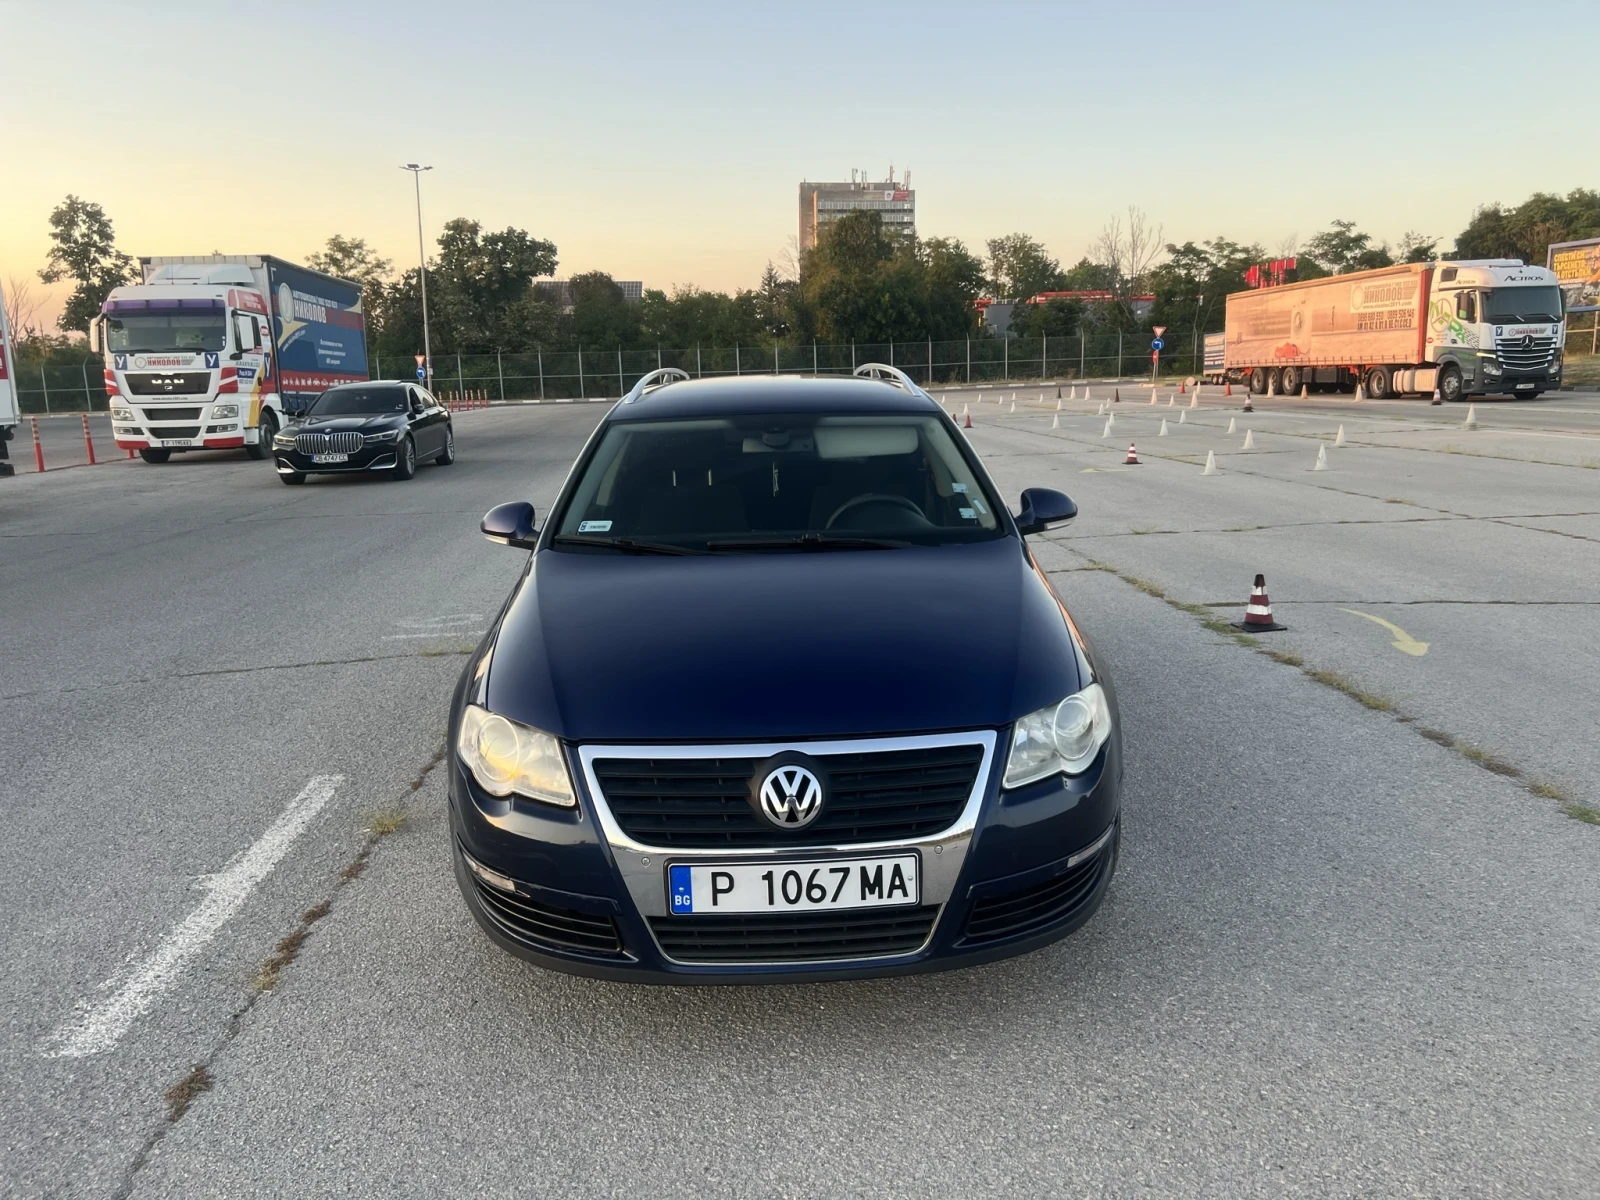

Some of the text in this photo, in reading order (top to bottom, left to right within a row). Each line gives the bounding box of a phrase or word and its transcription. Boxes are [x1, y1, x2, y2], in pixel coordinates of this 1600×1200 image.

[1364, 287, 1403, 304] НИКОЛОВ
[294, 299, 327, 323] НИКОЛОВ
[711, 863, 909, 907] P 1067 MA
[674, 895, 691, 906] BG
